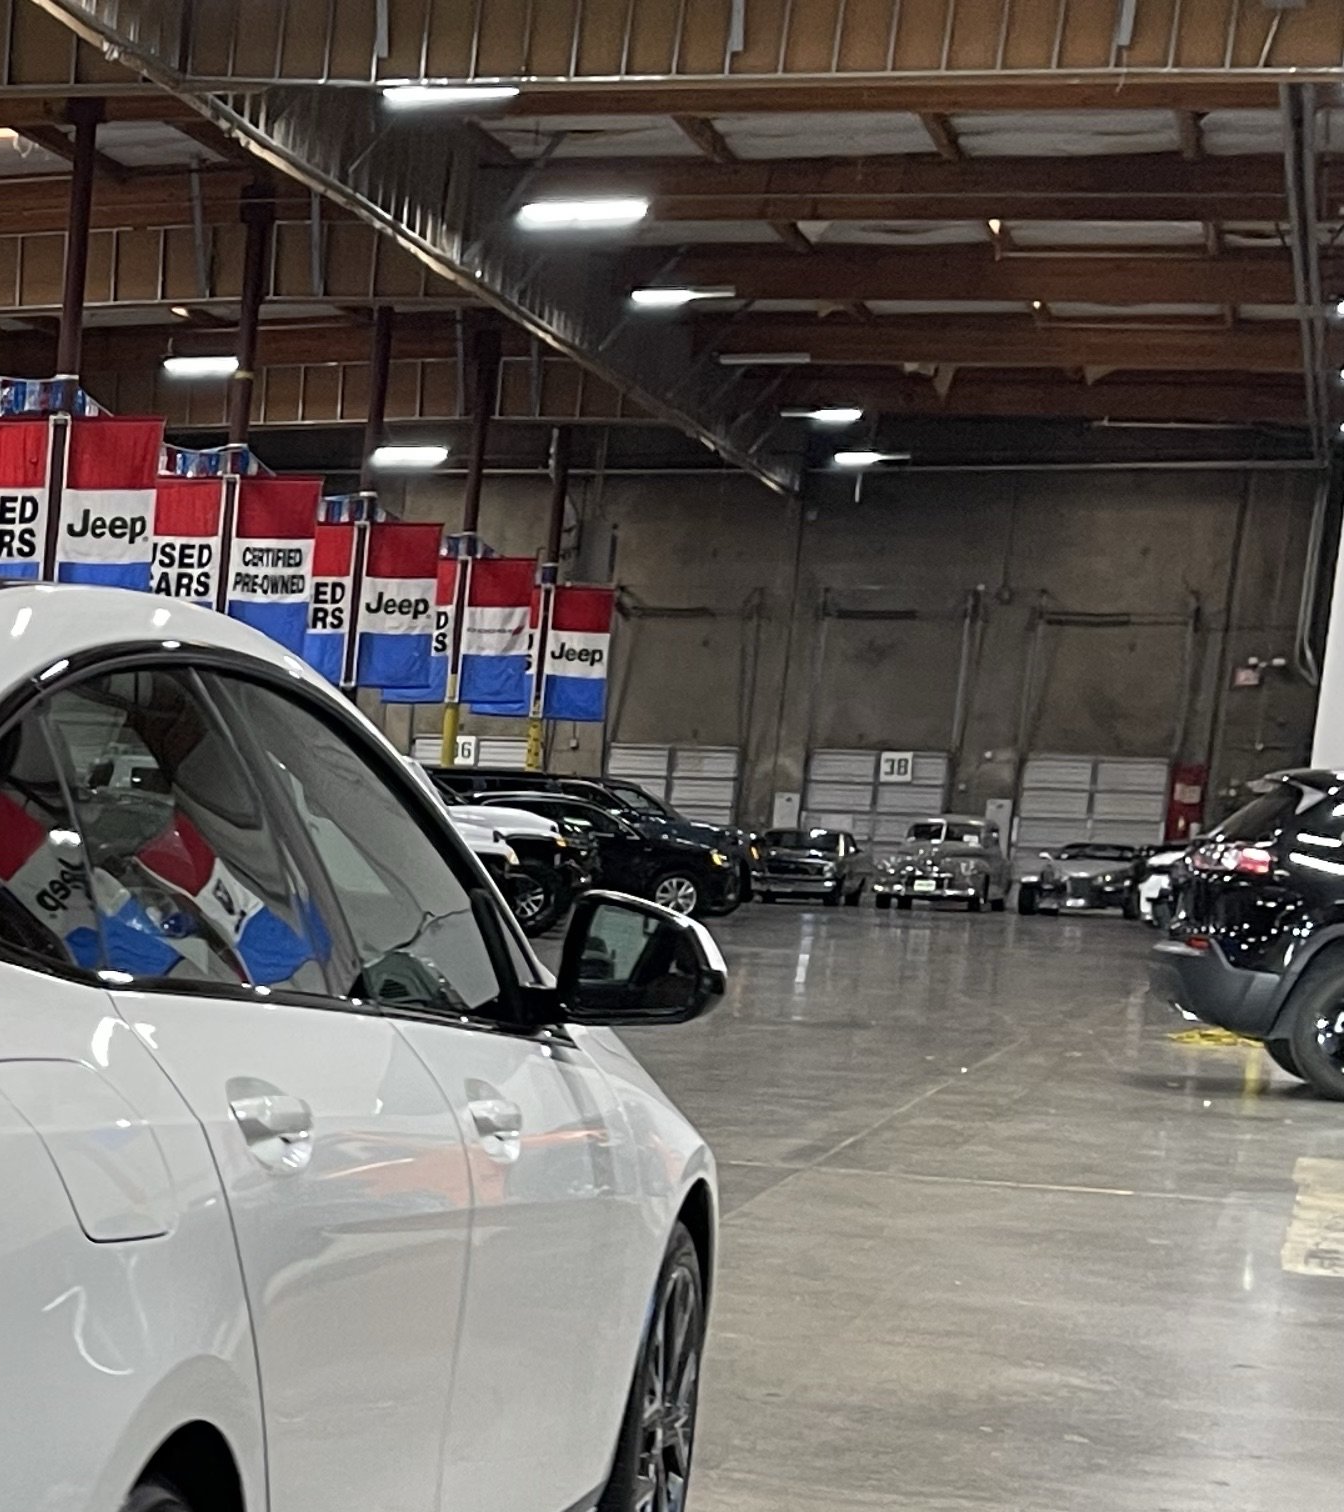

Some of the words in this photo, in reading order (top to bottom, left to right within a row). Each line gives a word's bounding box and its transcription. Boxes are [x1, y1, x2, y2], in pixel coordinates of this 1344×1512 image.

[67, 509, 146, 544] Jeep
[242, 547, 303, 568] CERTIFIED
[150, 571, 210, 597] ARS
[233, 572, 305, 594] PRE-OWNED
[314, 582, 346, 604] ED
[365, 592, 429, 619] Jeep
[312, 607, 344, 629] RS
[551, 643, 603, 667] Jeep
[884, 757, 909, 776] 38
